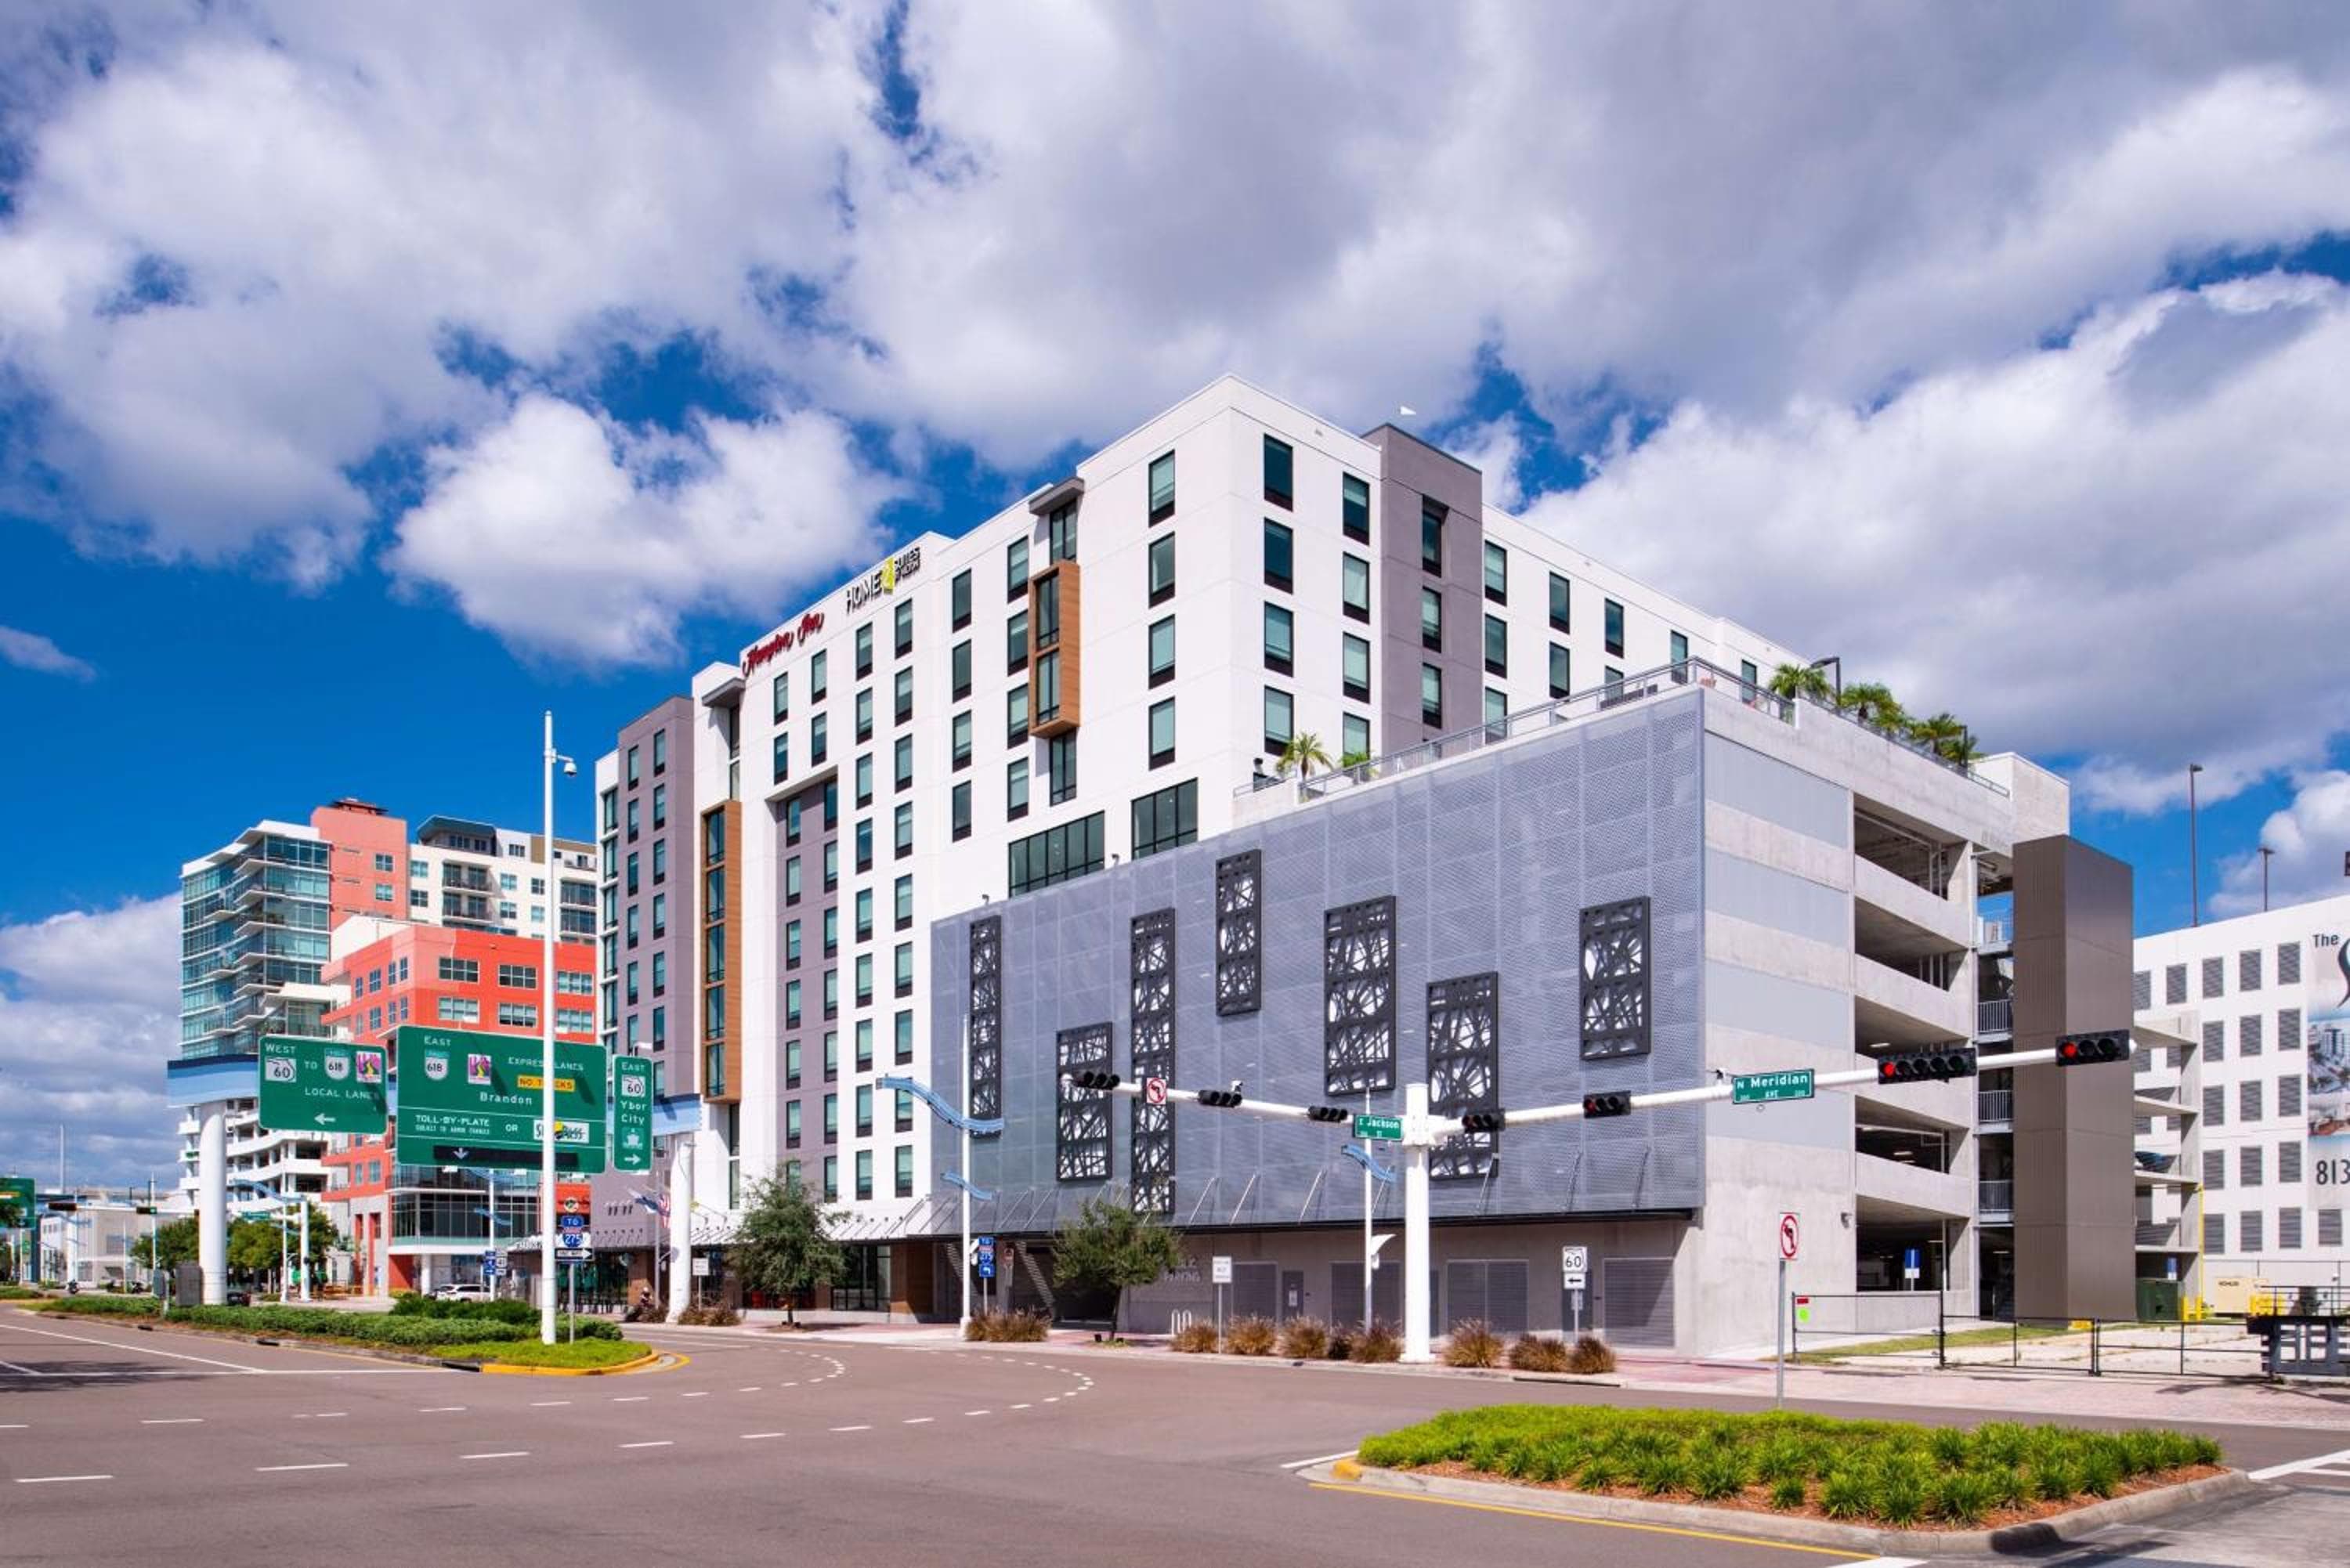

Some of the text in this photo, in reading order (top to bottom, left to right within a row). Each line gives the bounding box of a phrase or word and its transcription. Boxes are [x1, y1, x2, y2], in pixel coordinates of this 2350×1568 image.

[742, 612, 825, 677] Hampton Inn
[2312, 934, 2340, 948] The
[423, 1035, 452, 1047] EAST
[265, 1042, 296, 1053] WEST
[303, 1060, 319, 1070] TO
[327, 1062, 344, 1072] 618
[427, 1063, 443, 1072] 618
[620, 1062, 646, 1072] EAST
[273, 1066, 291, 1078] 60
[1736, 1074, 1808, 1089] N Meridian
[304, 1087, 341, 1097] LOCAL
[627, 1082, 642, 1094] 60
[479, 1092, 533, 1105] Brandon
[620, 1100, 647, 1111] Ybor
[620, 1115, 645, 1126] City
[1367, 1116, 1400, 1129] Jackson
[504, 1123, 519, 1133] OR
[565, 1234, 581, 1245] 275
[1565, 1255, 1582, 1268] 60
